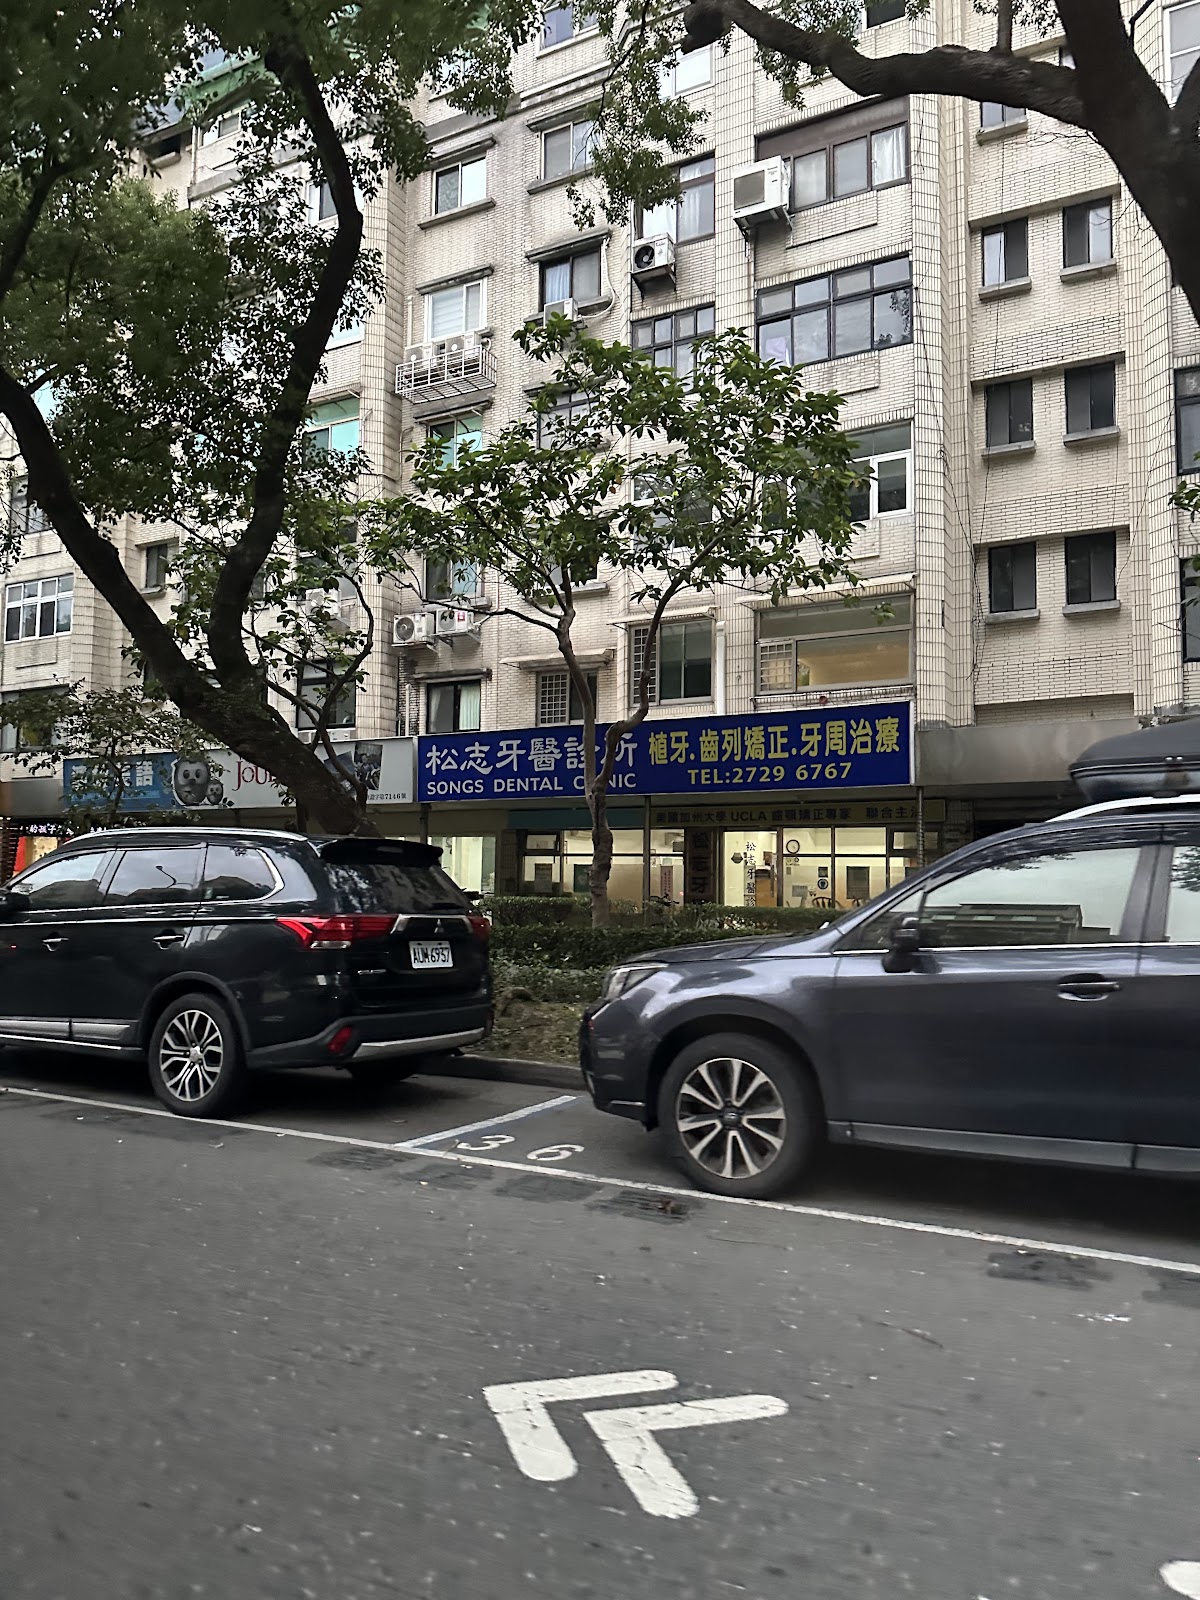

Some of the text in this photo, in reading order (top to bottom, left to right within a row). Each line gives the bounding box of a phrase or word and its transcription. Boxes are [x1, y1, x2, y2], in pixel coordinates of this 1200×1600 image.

[425, 733, 638, 775] 松志牙醫診所
[427, 773, 637, 796] SONGS DENTAL CNIC
[688, 762, 852, 785] TEL:2729 6767
[731, 811, 767, 821] UCLA
